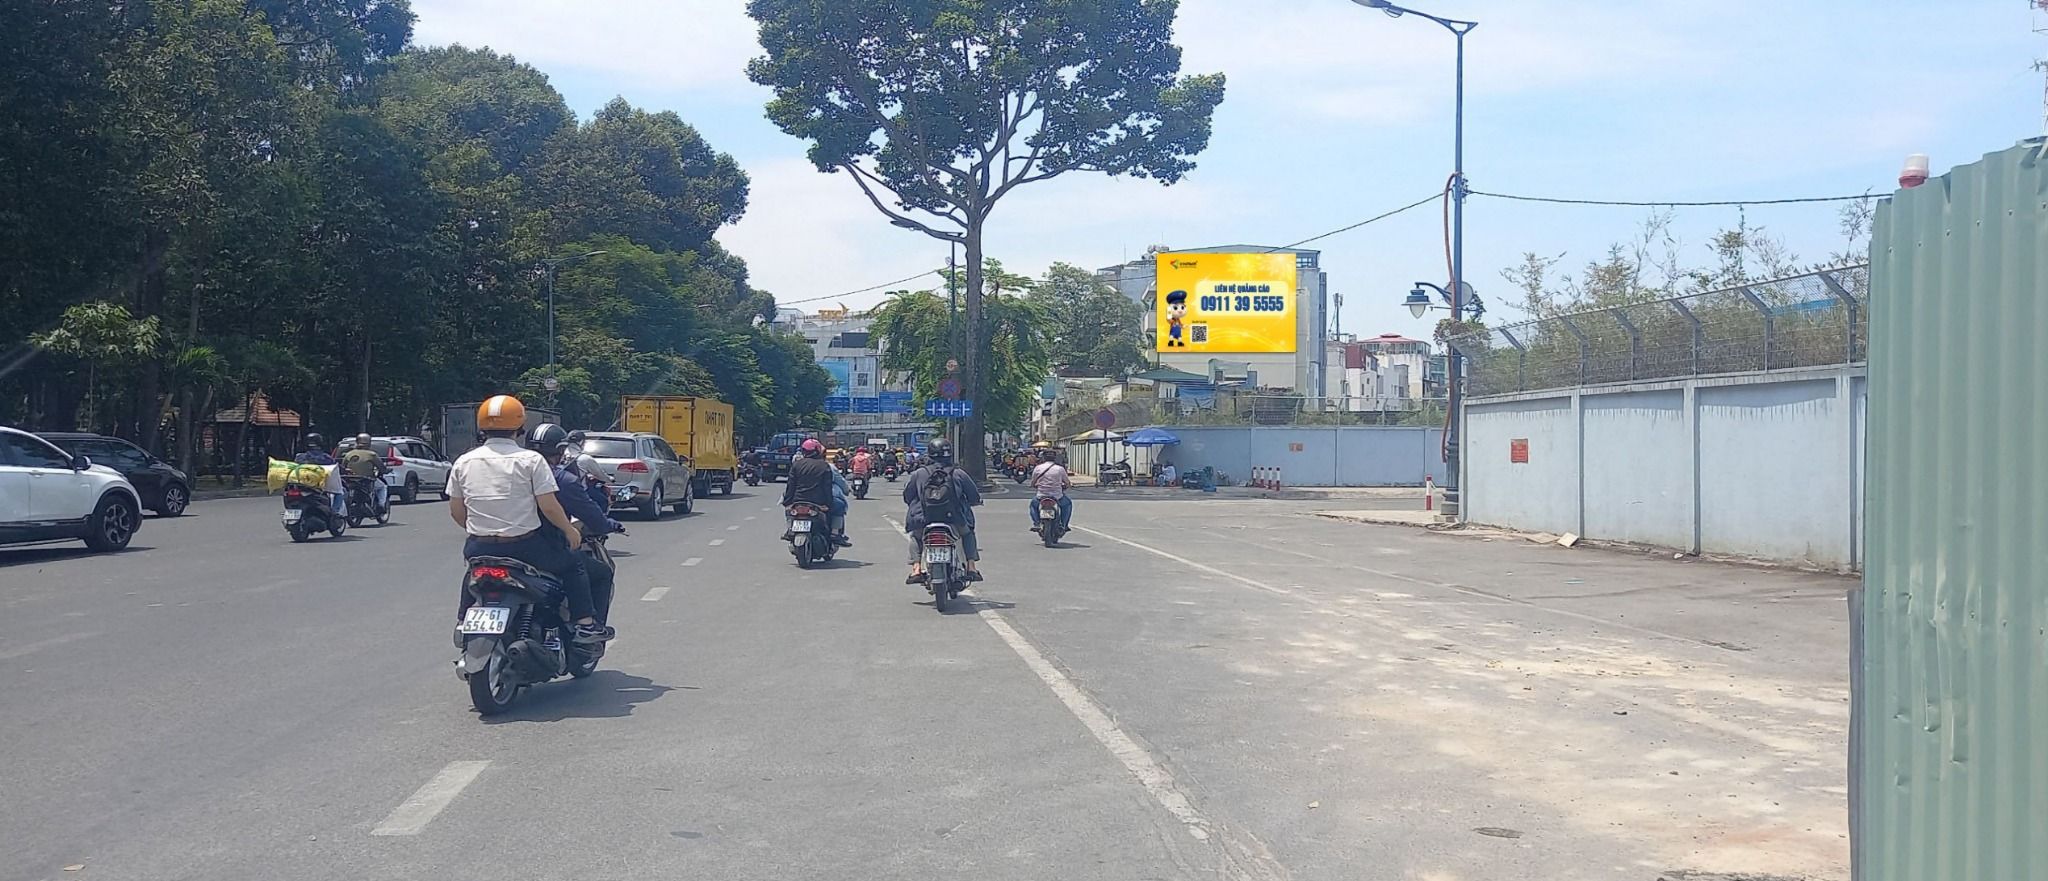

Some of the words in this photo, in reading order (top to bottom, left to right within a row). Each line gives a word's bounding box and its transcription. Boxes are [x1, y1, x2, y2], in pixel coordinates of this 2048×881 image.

[1214, 284, 1228, 293] LIÊN
[1237, 283, 1257, 294] QUẢNG
[1258, 284, 1270, 293] CÁO
[1201, 295, 1230, 311] 0911
[1234, 295, 1250, 311] 39
[1253, 295, 1284, 311] 5555
[471, 609, 501, 620] 77-G1
[463, 621, 504, 632] 554.48
